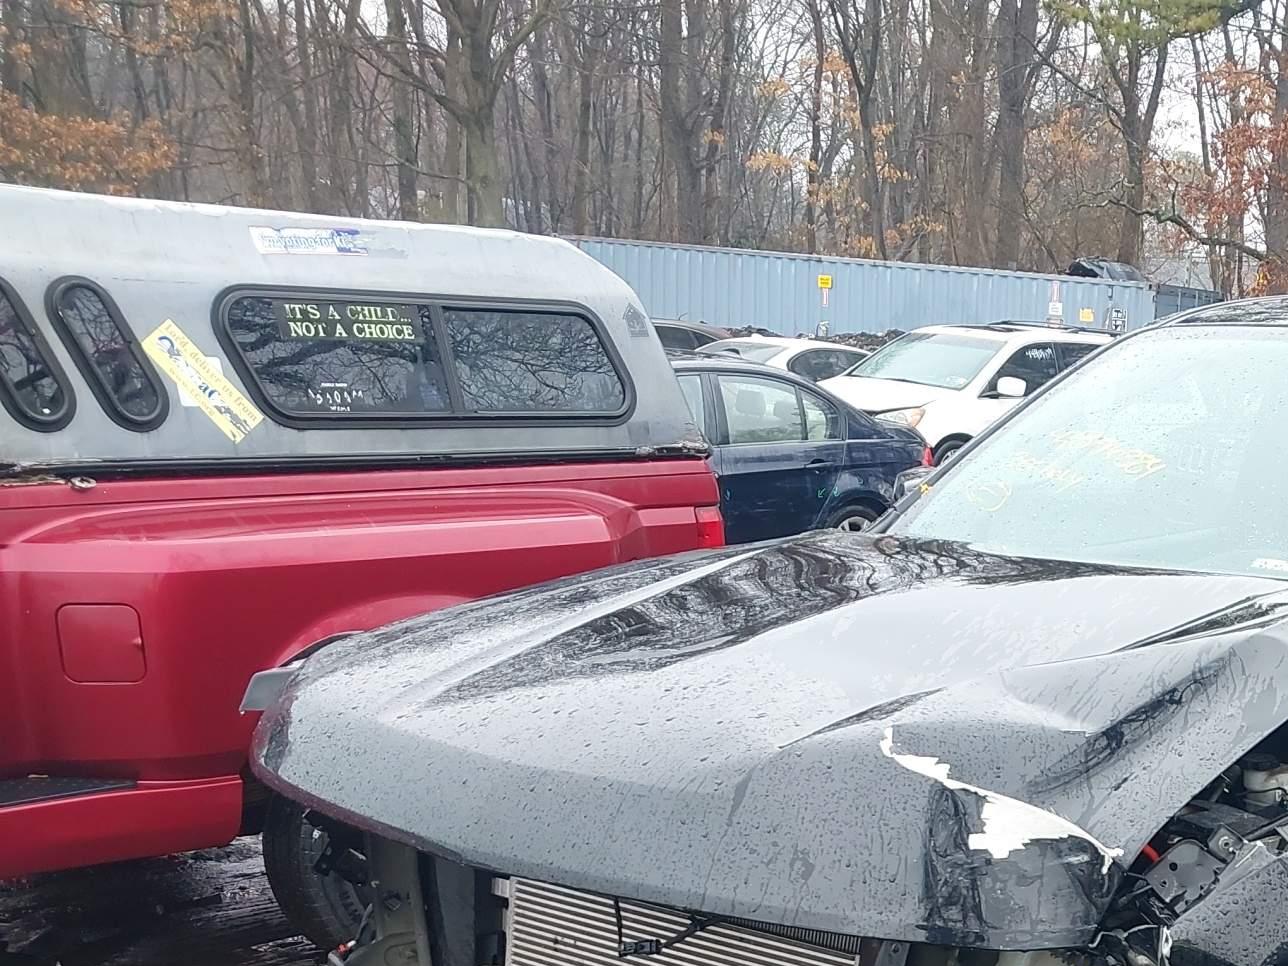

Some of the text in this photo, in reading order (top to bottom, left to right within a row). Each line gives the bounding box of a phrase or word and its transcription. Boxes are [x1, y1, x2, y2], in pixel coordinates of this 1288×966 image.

[283, 303, 321, 319] IT'S
[328, 304, 341, 319] A
[288, 321, 415, 339] NOT A CHOICE
[190, 351, 220, 383] deliver
[221, 384, 234, 398] us
[234, 396, 259, 422] from
